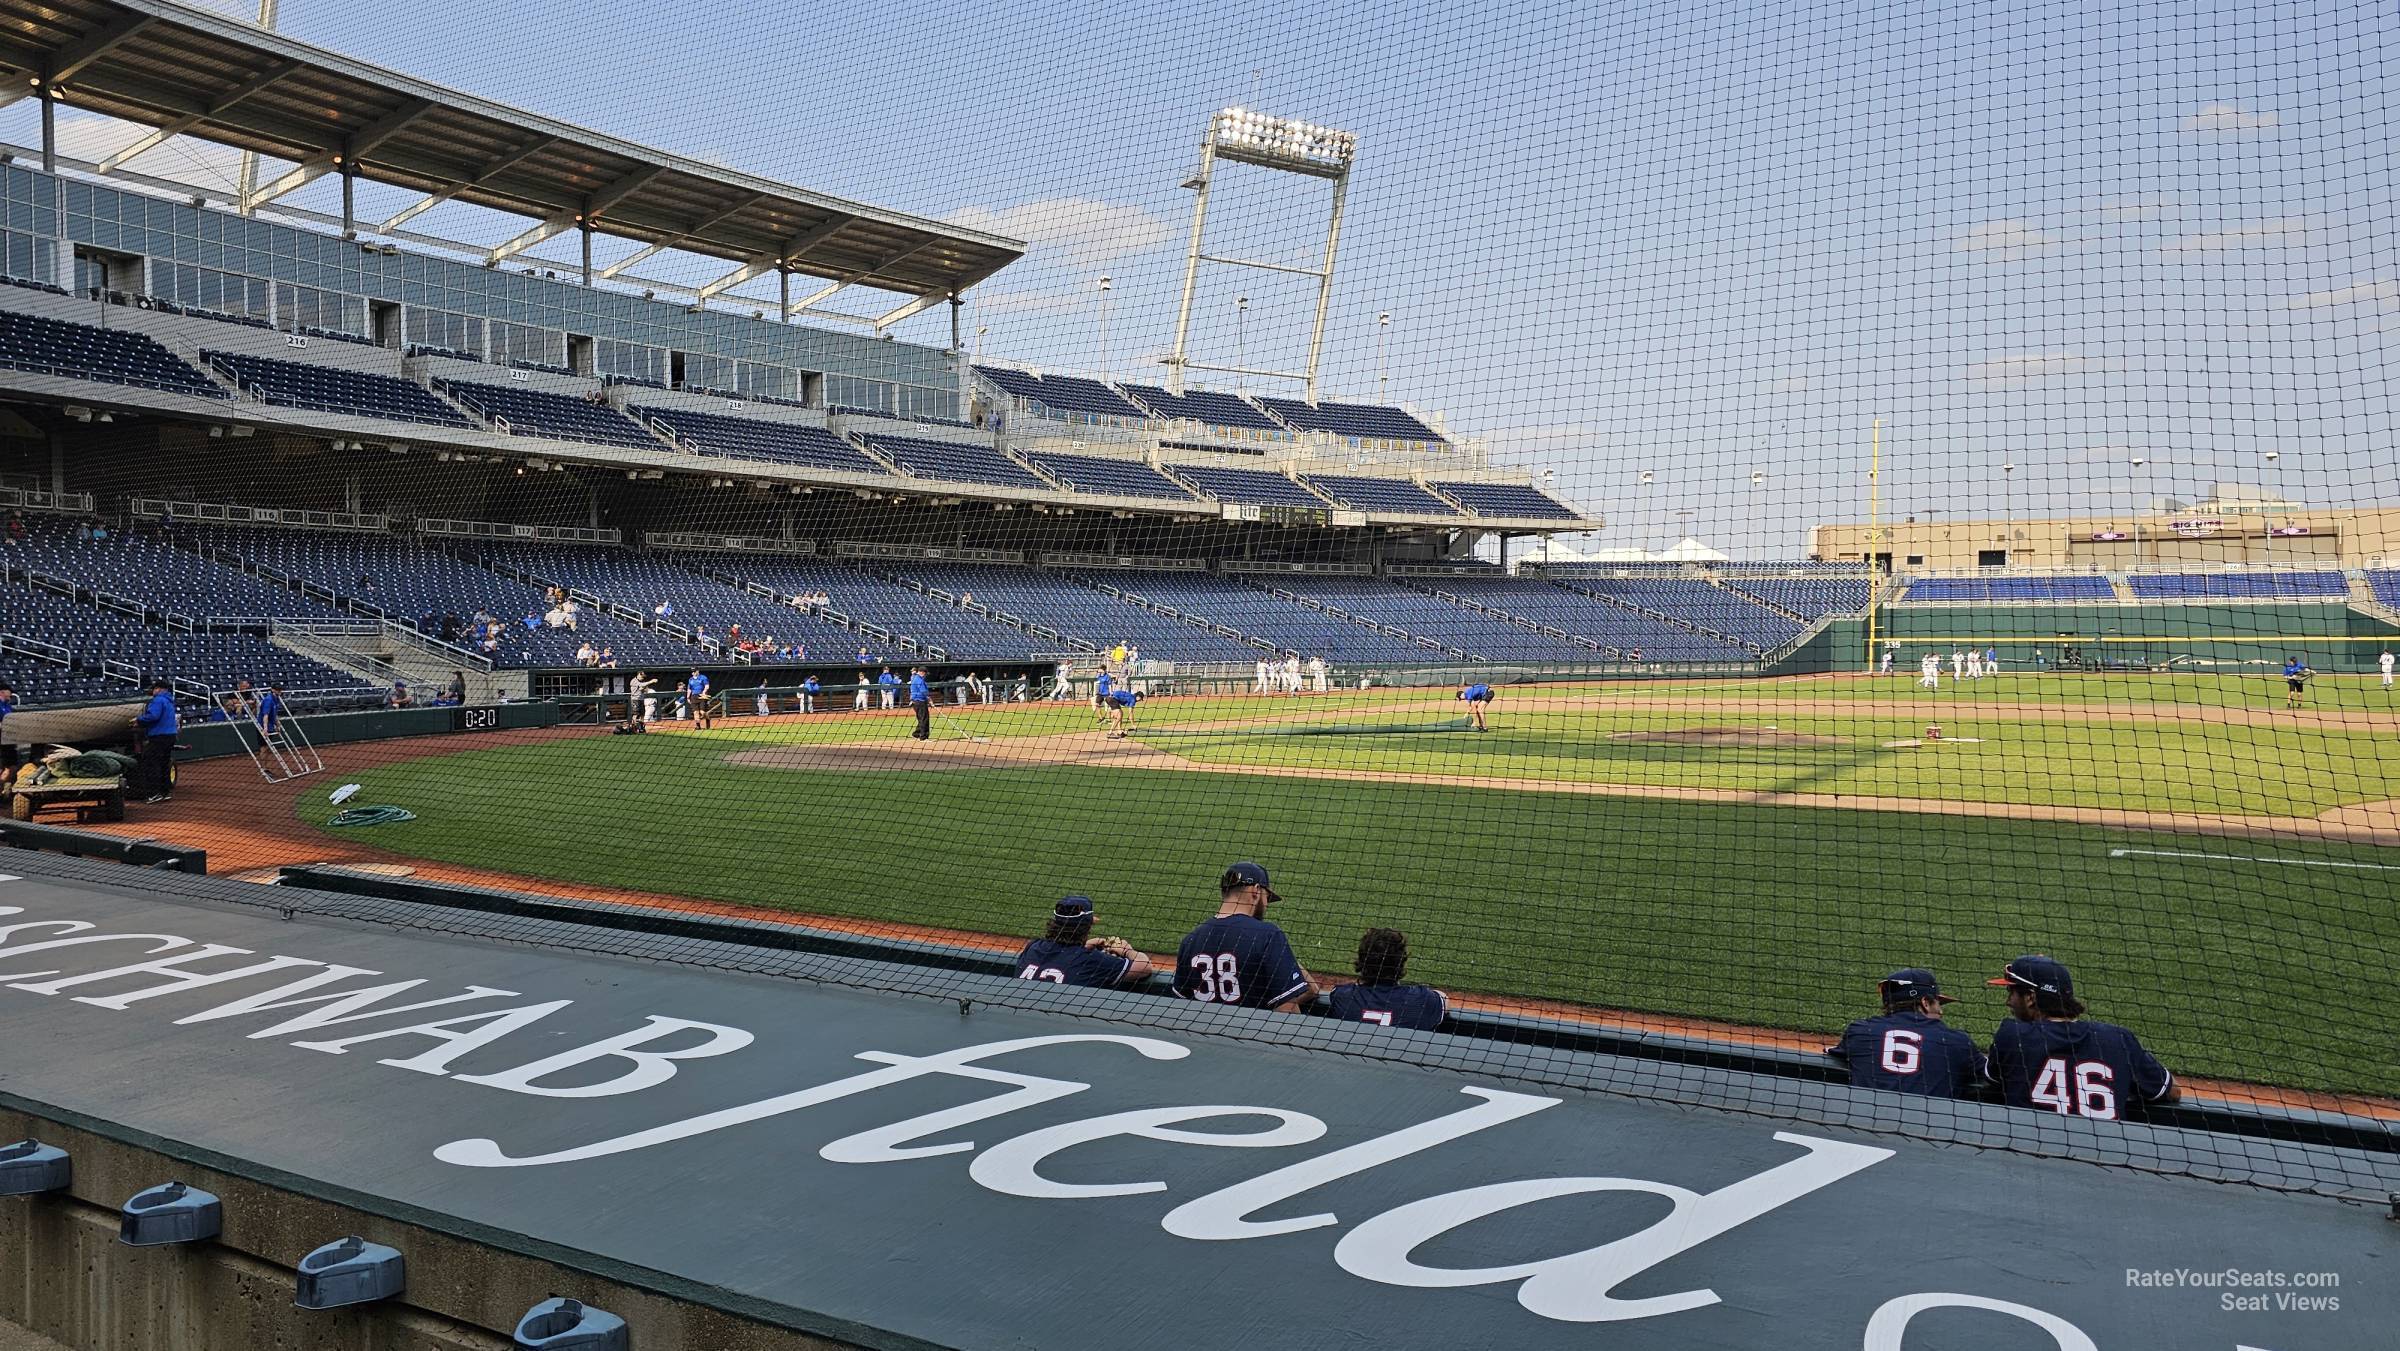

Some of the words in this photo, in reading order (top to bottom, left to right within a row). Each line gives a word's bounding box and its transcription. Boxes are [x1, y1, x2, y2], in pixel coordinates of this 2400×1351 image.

[288, 336, 306, 346] 216
[512, 371, 527, 379] 217
[729, 401, 742, 409] 218
[257, 511, 275, 519] 116
[516, 527, 530, 535] 117
[728, 539, 740, 547] 118
[465, 709, 496, 728] 0:20
[1190, 952, 1241, 1002] 38
[1880, 1028, 1924, 1074] 6
[2031, 1057, 2120, 1121] 46
[432, 1034, 1896, 1323] field
